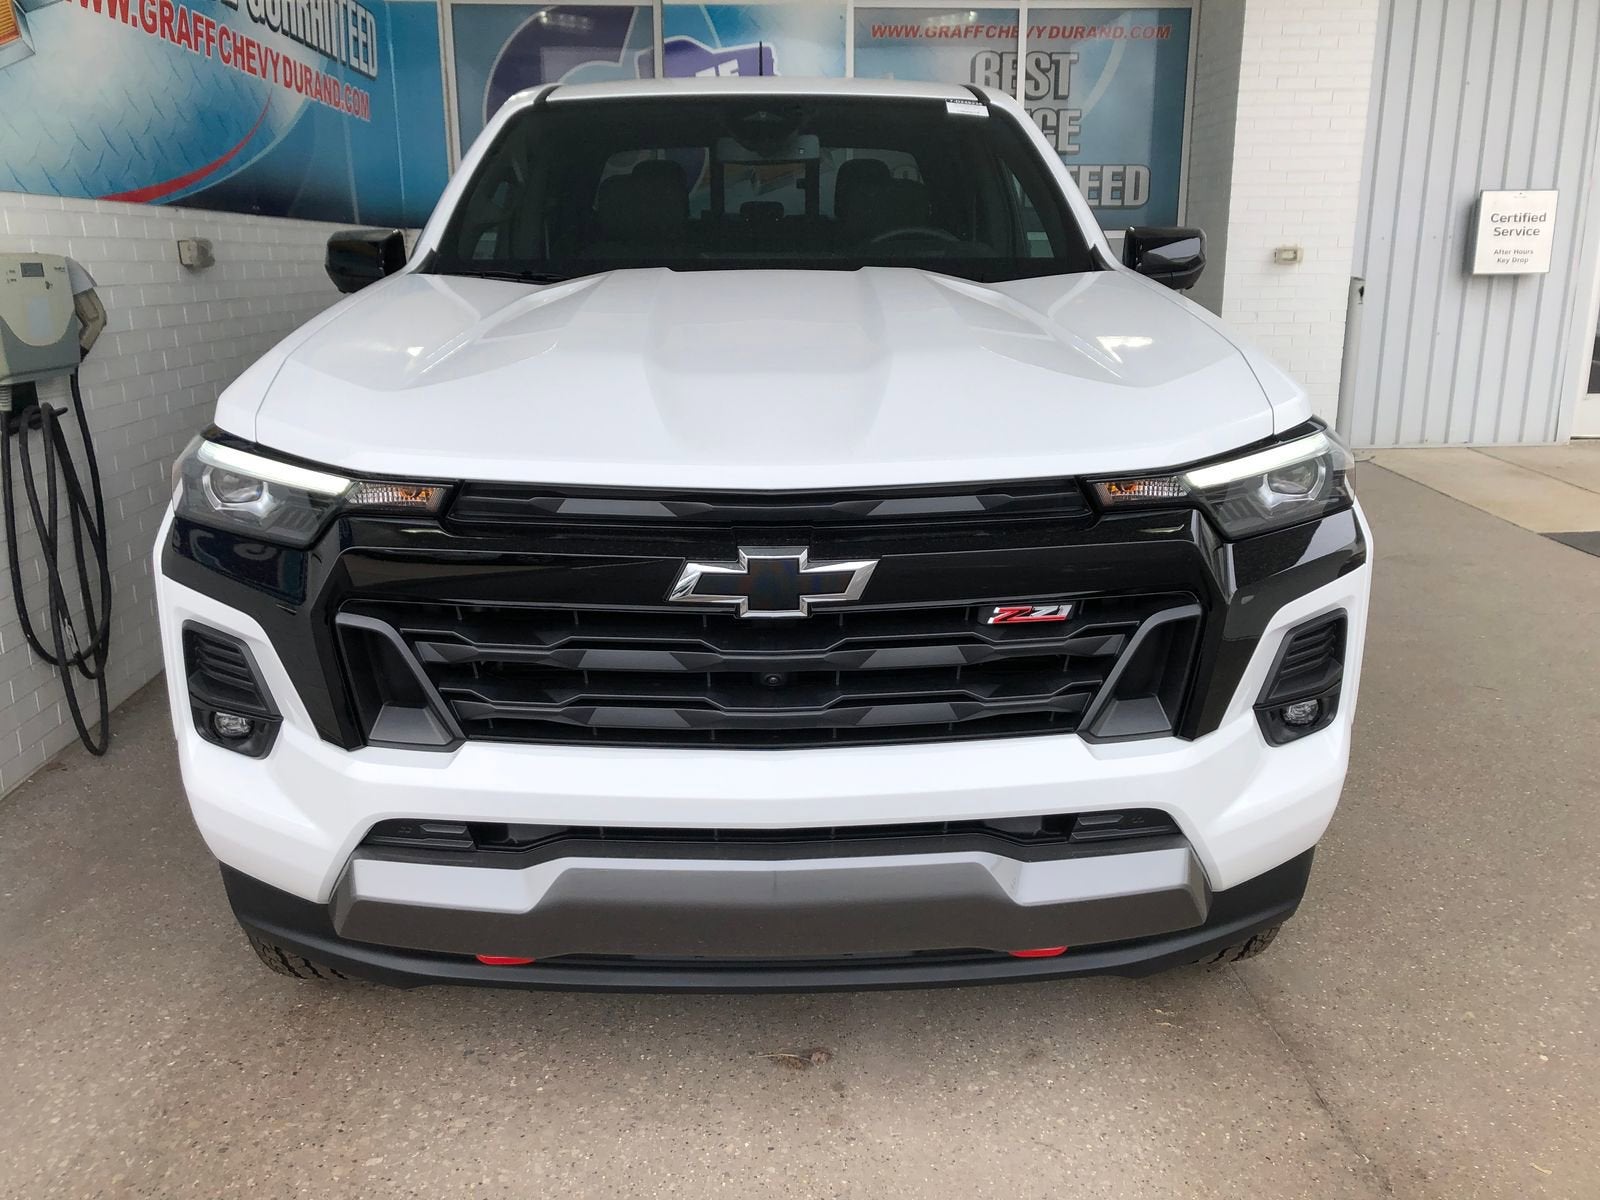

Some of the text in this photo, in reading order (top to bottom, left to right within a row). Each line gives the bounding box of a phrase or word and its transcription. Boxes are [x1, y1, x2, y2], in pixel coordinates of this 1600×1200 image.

[65, 0, 371, 121] W.GRAFFCHEVYDURAND.COM
[970, 50, 1079, 100] BEST
[1490, 212, 1547, 223] Certified
[1493, 226, 1541, 237] Service
